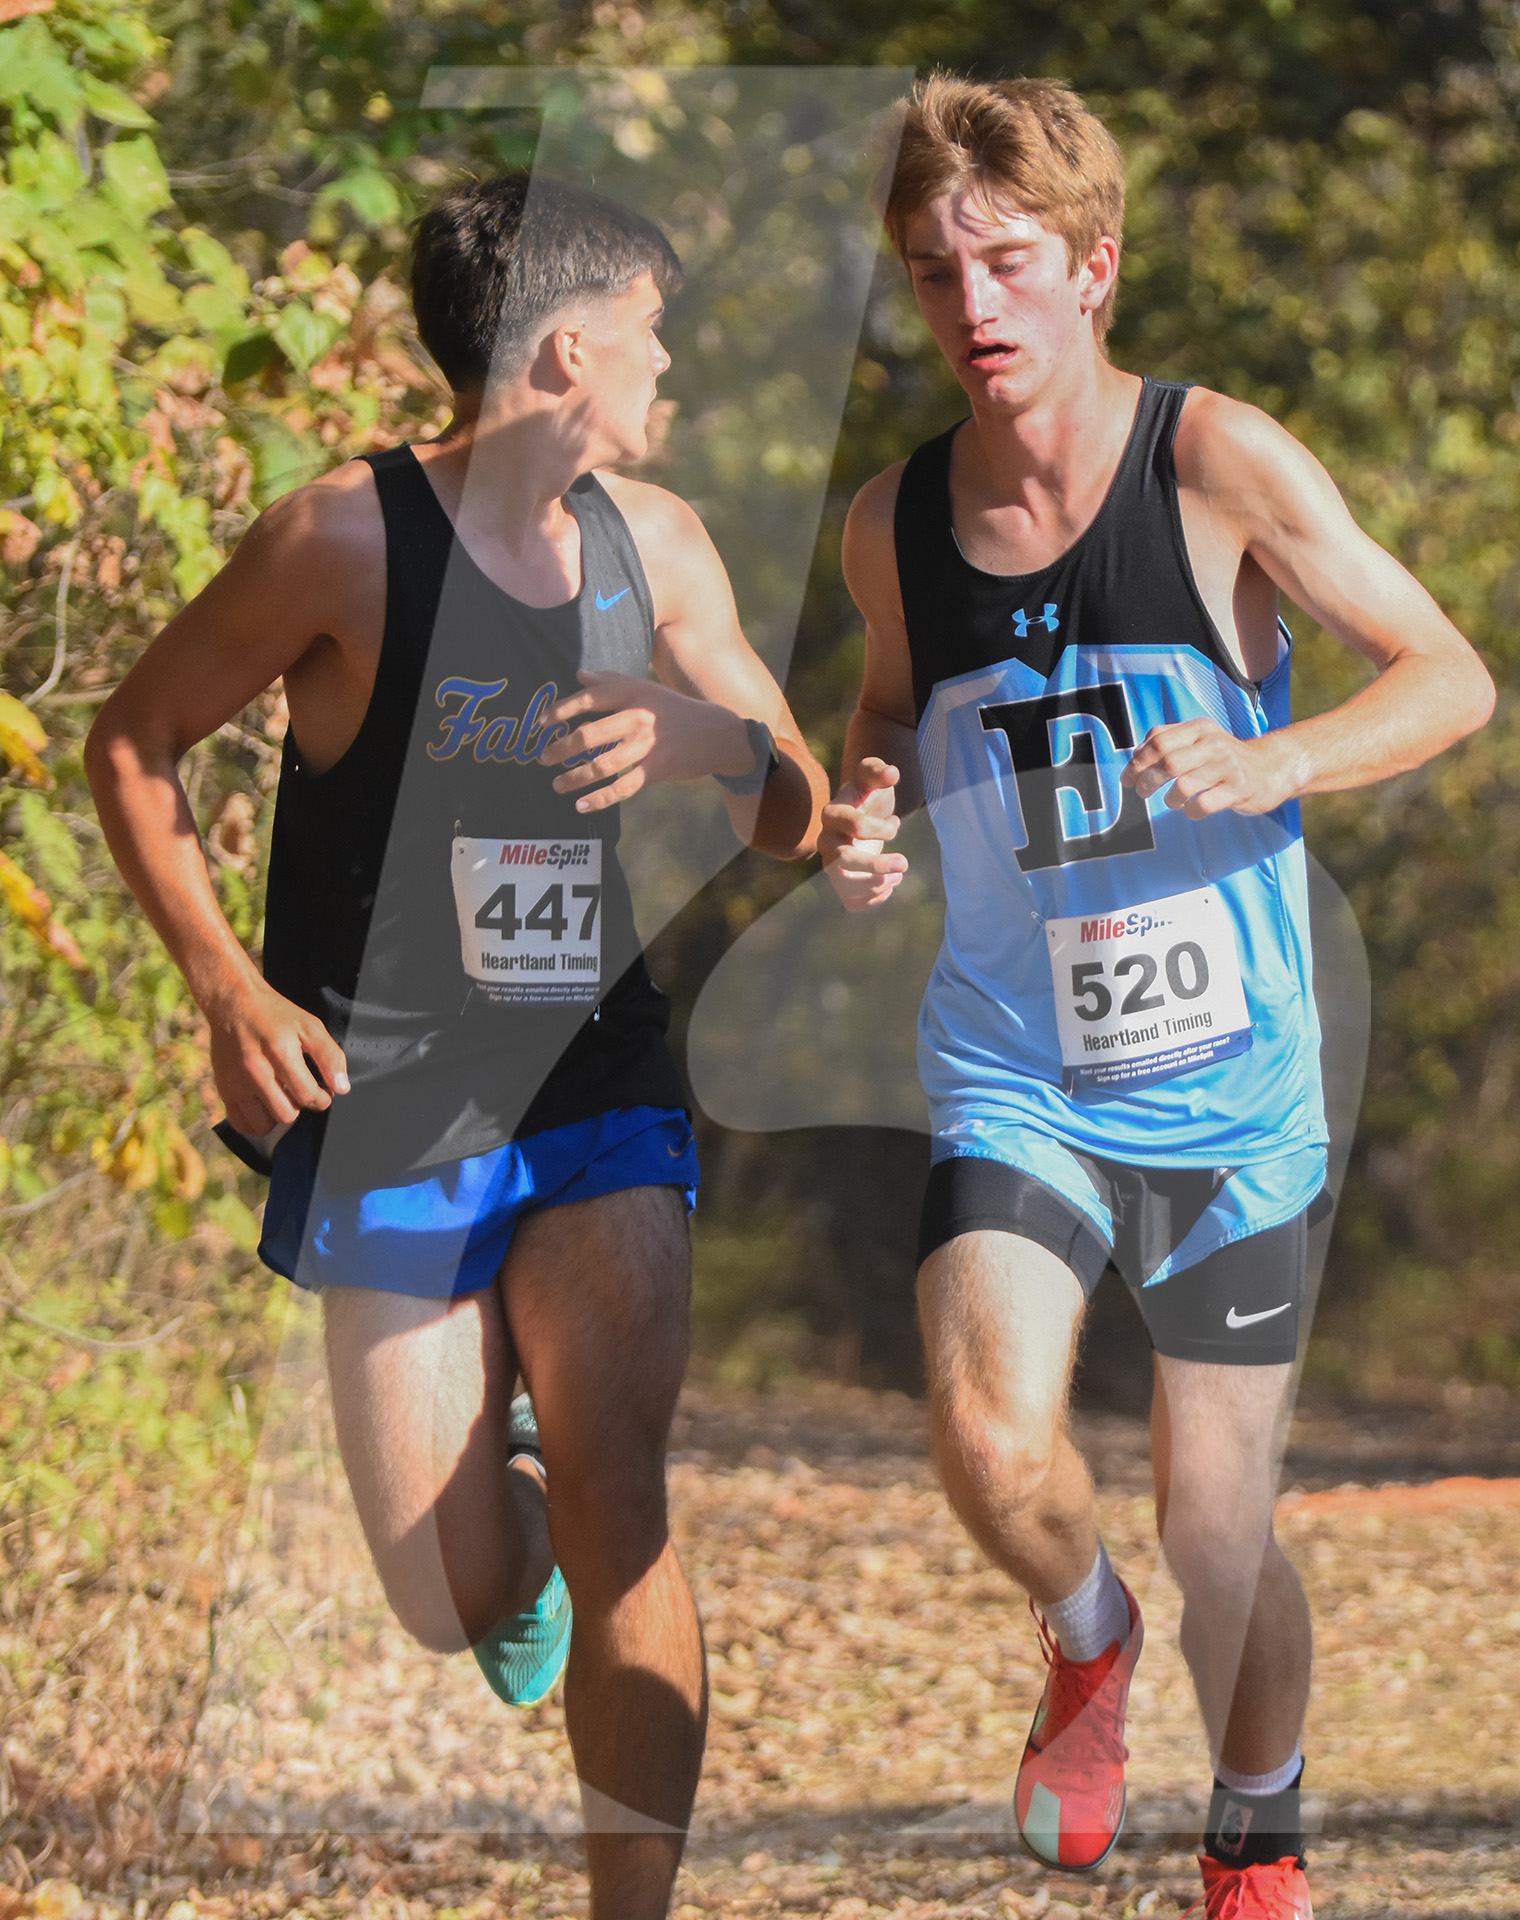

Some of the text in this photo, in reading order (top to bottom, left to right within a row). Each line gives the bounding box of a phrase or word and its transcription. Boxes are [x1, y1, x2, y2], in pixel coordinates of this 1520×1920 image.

[977, 681, 1156, 873] E
[499, 843, 590, 869] MileSplit
[474, 883, 600, 941] 447
[481, 952, 598, 972] Heartland Timing
[1071, 941, 1209, 1021] 520
[1083, 1011, 1213, 1051] Heartland Timing
[1107, 1062, 1130, 1073] results
[1131, 1056, 1158, 1069] emailed
[1158, 1050, 1182, 1063] directly
[1110, 1073, 1120, 1082] up
[1120, 1071, 1131, 1079] for
[1137, 1067, 1151, 1076] free
[1151, 1060, 1178, 1073] account
